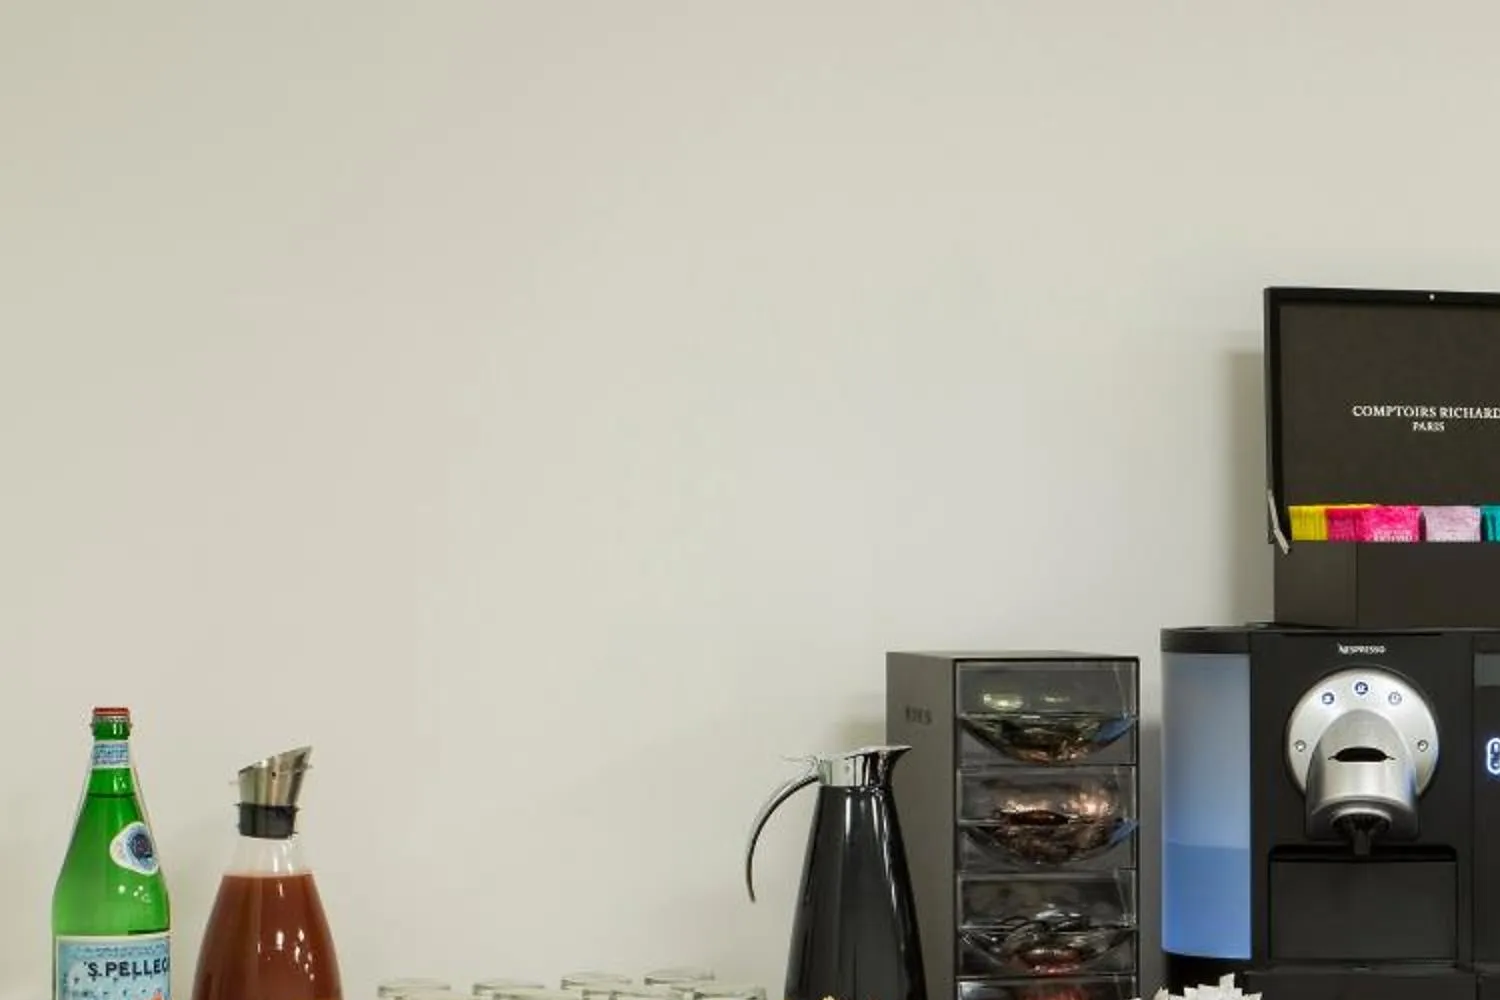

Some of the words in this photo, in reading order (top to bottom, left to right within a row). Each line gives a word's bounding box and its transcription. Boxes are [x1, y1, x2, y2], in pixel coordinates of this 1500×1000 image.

[1351, 404, 1437, 418] COMPTOIRS
[1412, 421, 1446, 432] PARIS
[1337, 642, 1386, 655] NESPRESSO
